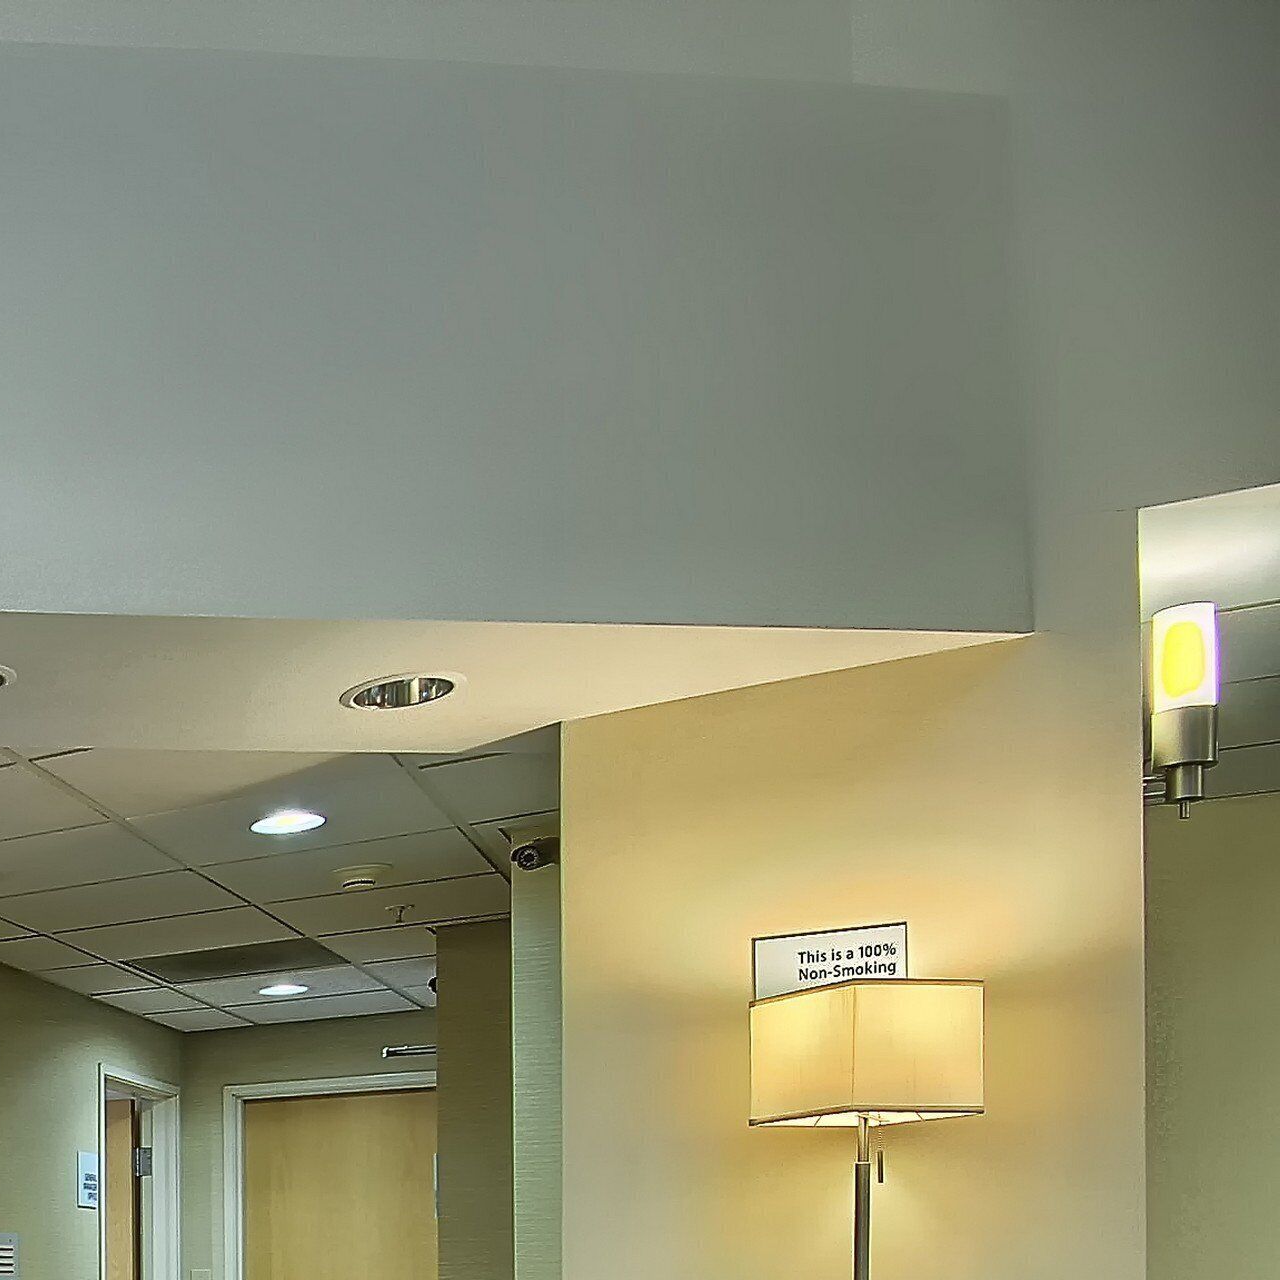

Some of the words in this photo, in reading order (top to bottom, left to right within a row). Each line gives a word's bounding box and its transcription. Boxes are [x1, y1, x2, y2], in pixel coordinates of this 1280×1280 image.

[797, 950, 827, 964] This
[831, 949, 842, 961] is
[846, 949, 854, 960] a
[858, 943, 897, 958] 100%
[797, 962, 897, 981] Non-Smoking
